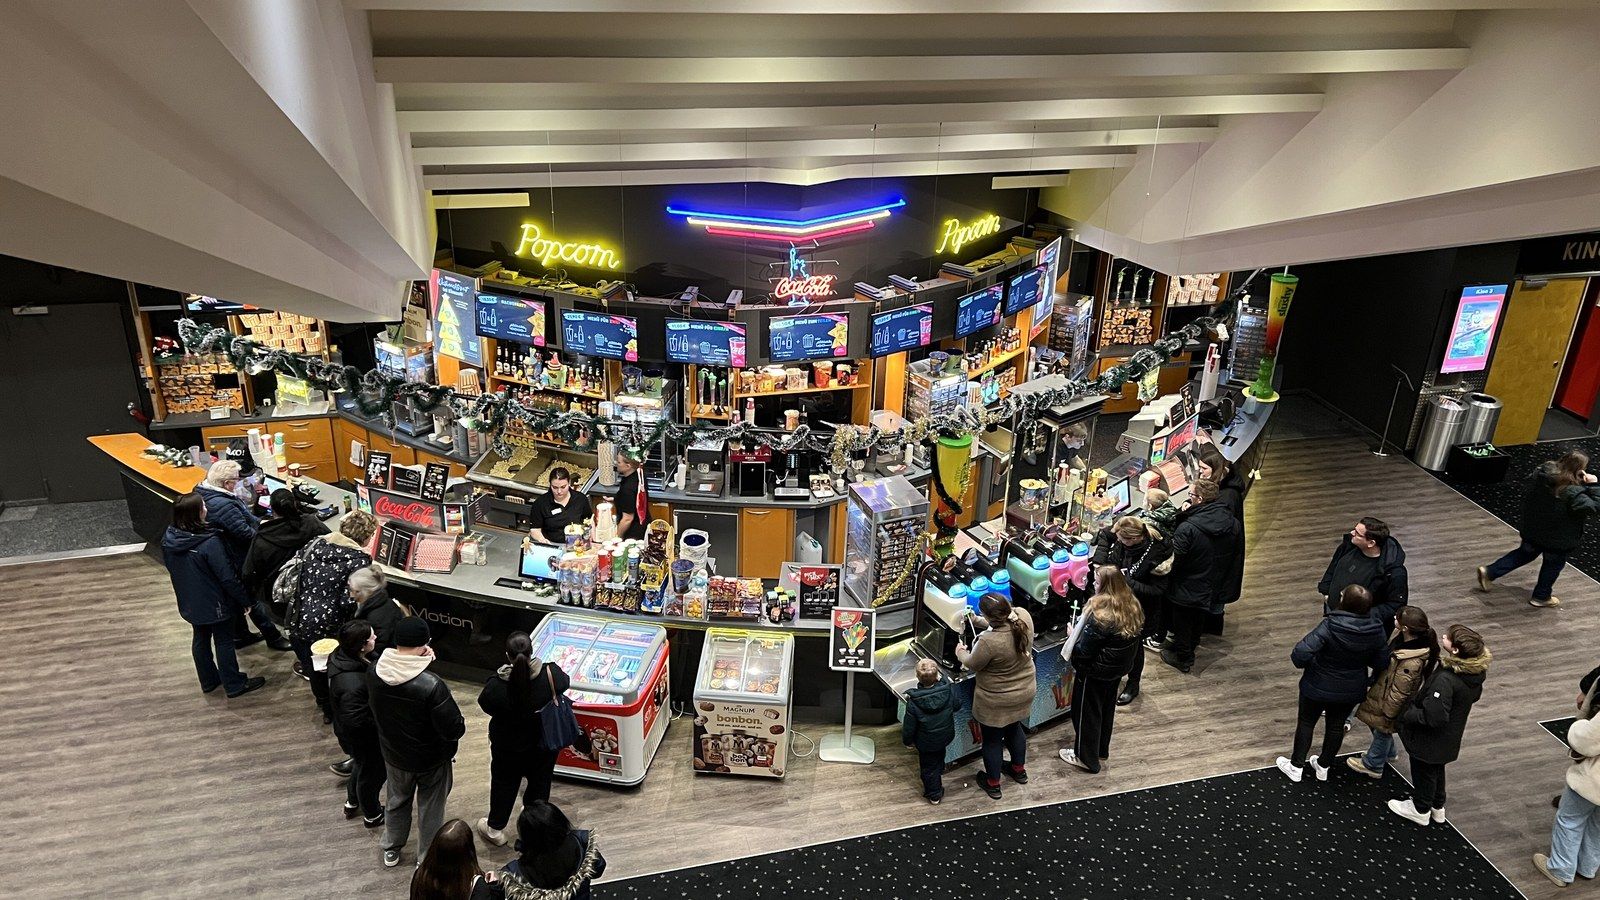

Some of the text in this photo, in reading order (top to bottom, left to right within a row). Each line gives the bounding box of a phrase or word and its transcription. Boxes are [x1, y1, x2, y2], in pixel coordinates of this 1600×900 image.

[515, 224, 619, 268] Popcorn
[936, 214, 1000, 254] Popcorn
[1563, 241, 1600, 260] KIN
